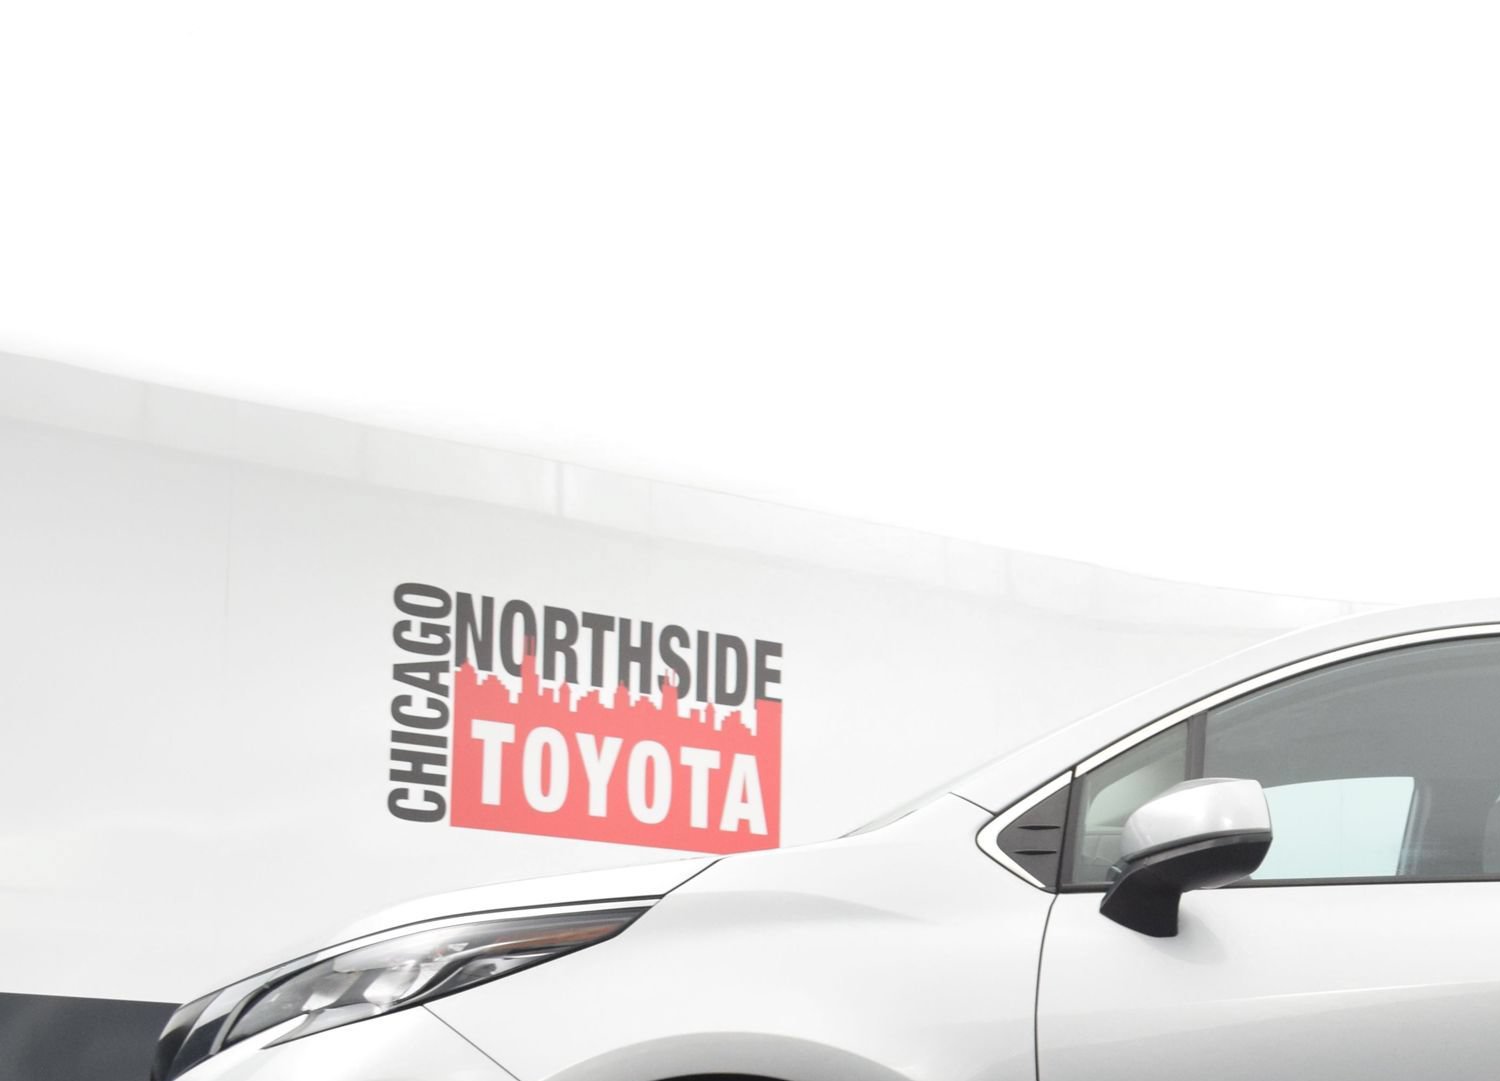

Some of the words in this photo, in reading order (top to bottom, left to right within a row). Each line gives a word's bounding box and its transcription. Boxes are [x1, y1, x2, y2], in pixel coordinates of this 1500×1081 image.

[387, 582, 452, 823] CHICAGO
[455, 590, 783, 707] NORTHSIDE
[470, 718, 769, 836] TOYOTA
